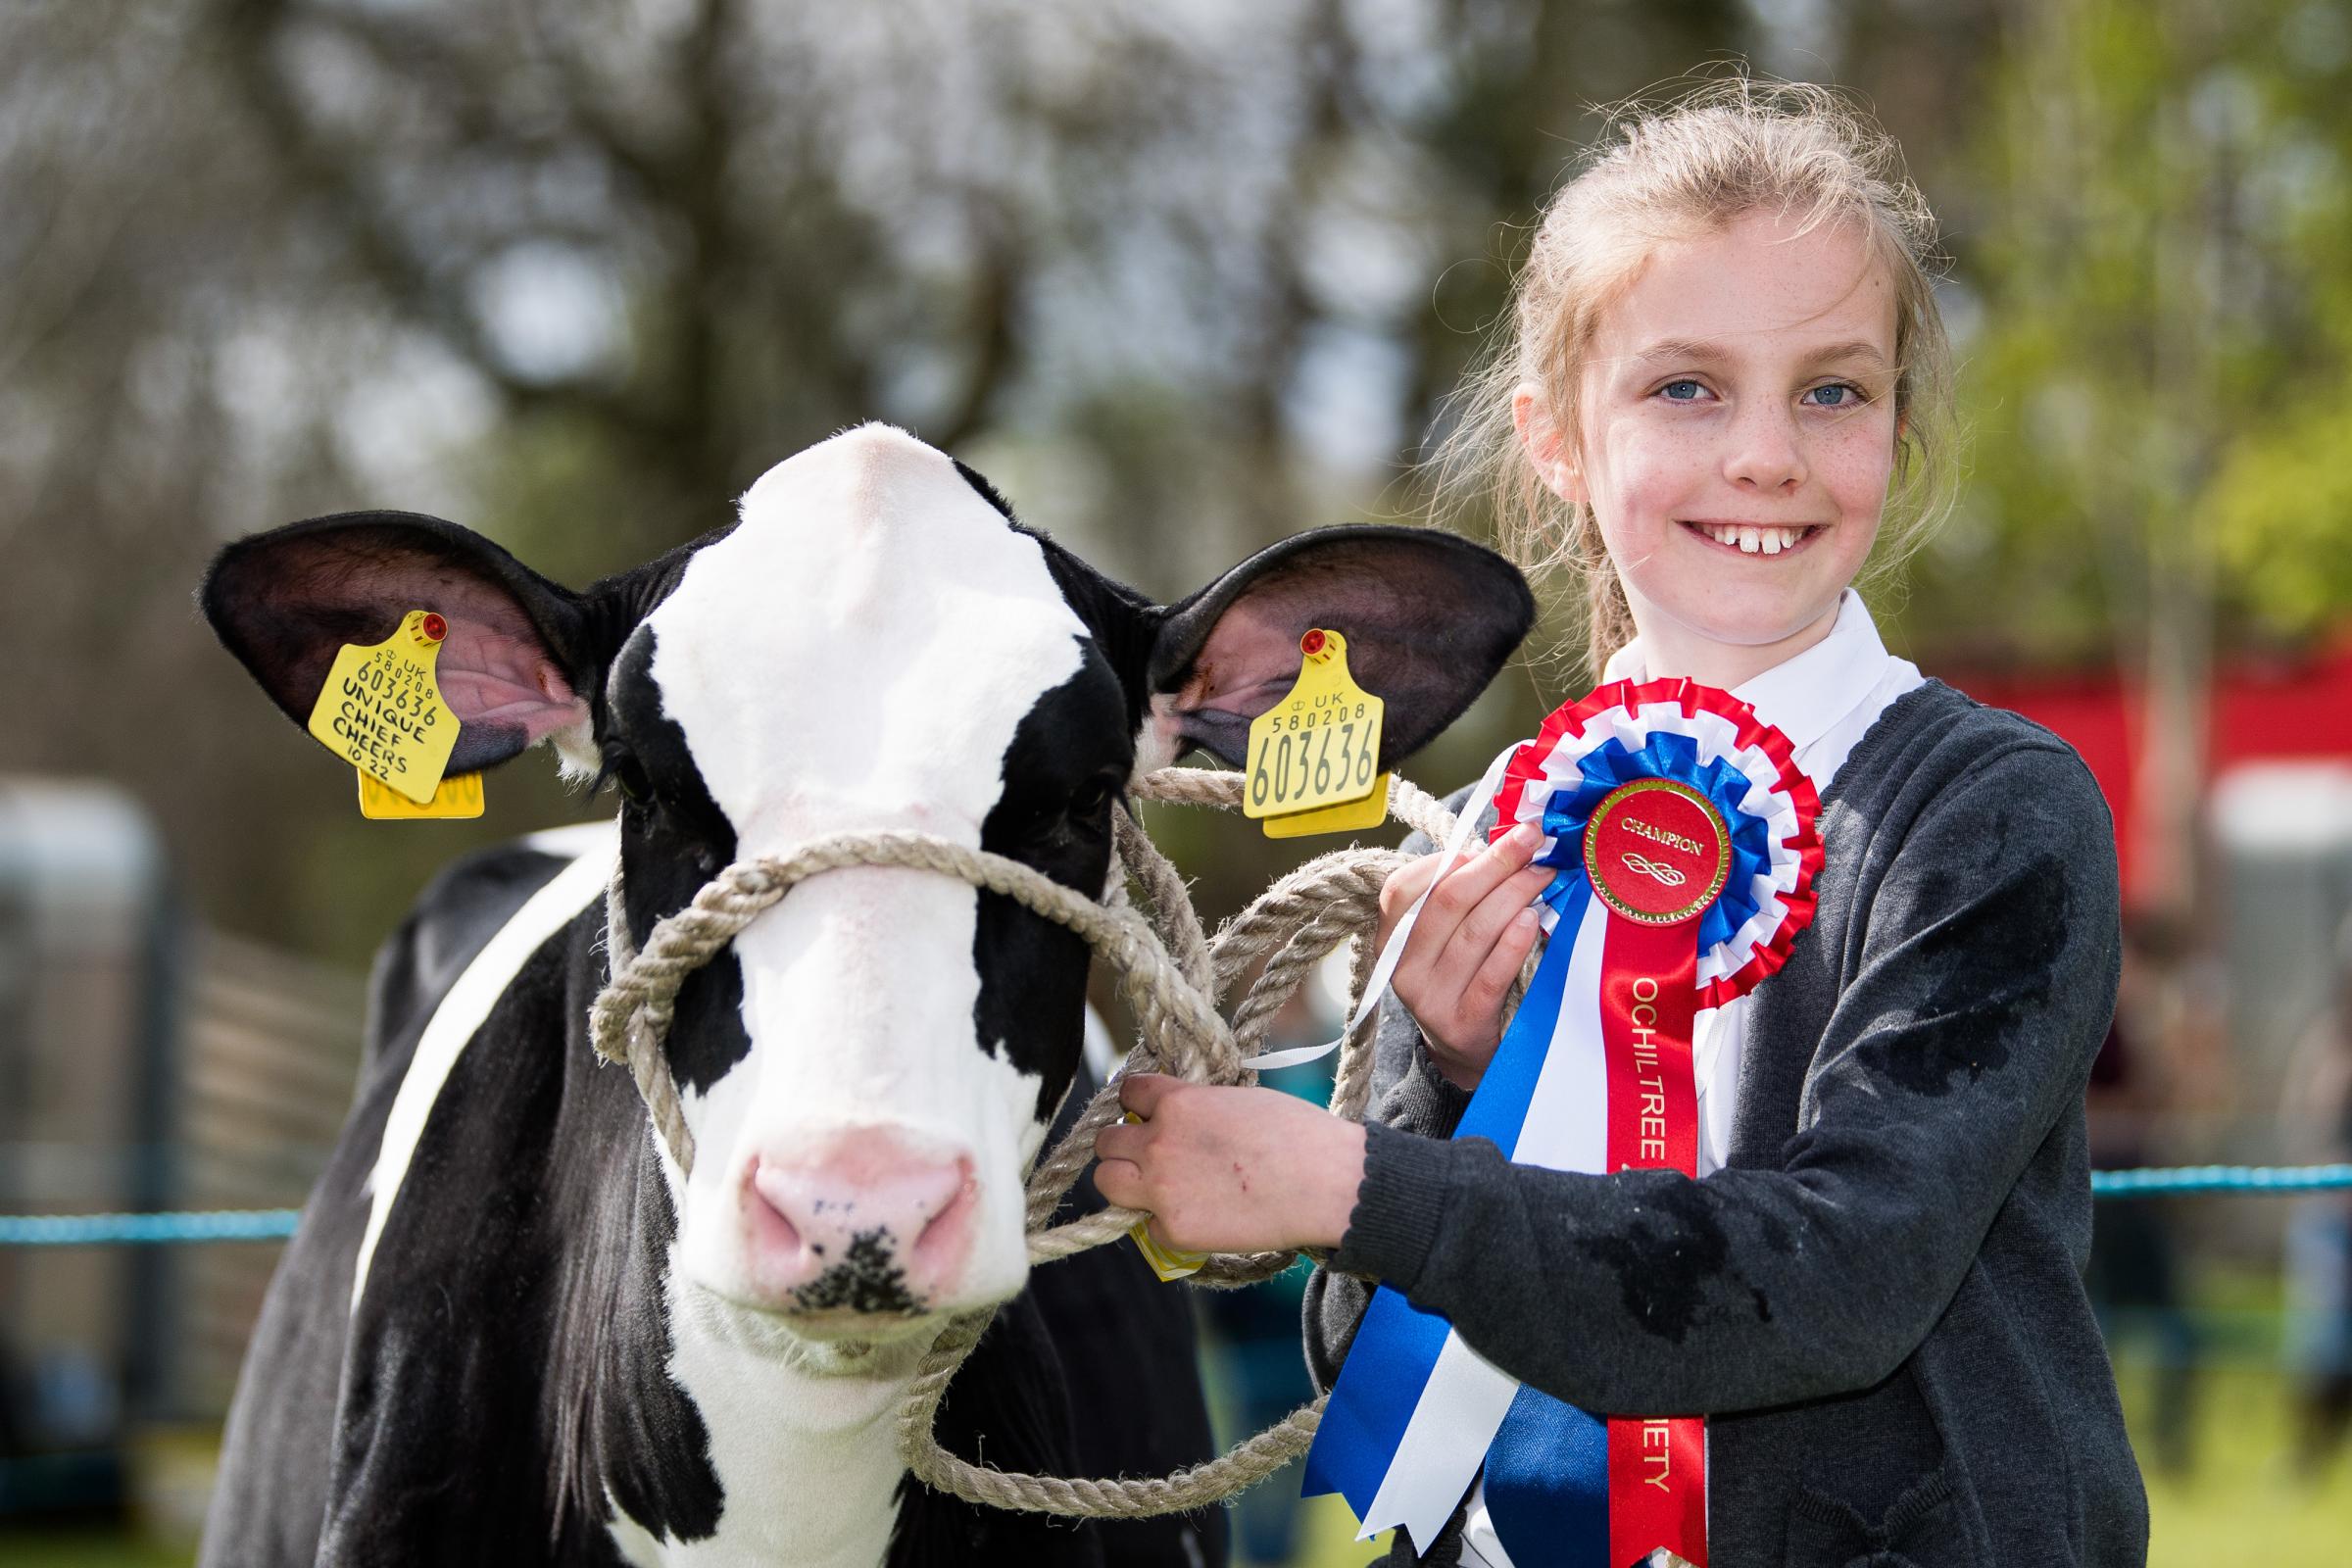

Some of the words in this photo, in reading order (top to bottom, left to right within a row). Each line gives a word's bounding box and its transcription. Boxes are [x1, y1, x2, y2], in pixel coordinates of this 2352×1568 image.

[358, 661, 436, 726] 603636
[404, 660, 426, 681] UK
[341, 701, 402, 747] CHIEF
[343, 677, 427, 744] UNIQUE
[1272, 703, 1365, 733] 580208
[1314, 692, 1345, 708] UK
[332, 716, 408, 773] CHEERS
[1251, 719, 1373, 807] 603636
[1621, 817, 1704, 856] CHAMPION
[1631, 977, 1666, 1160] OCHILTREE
